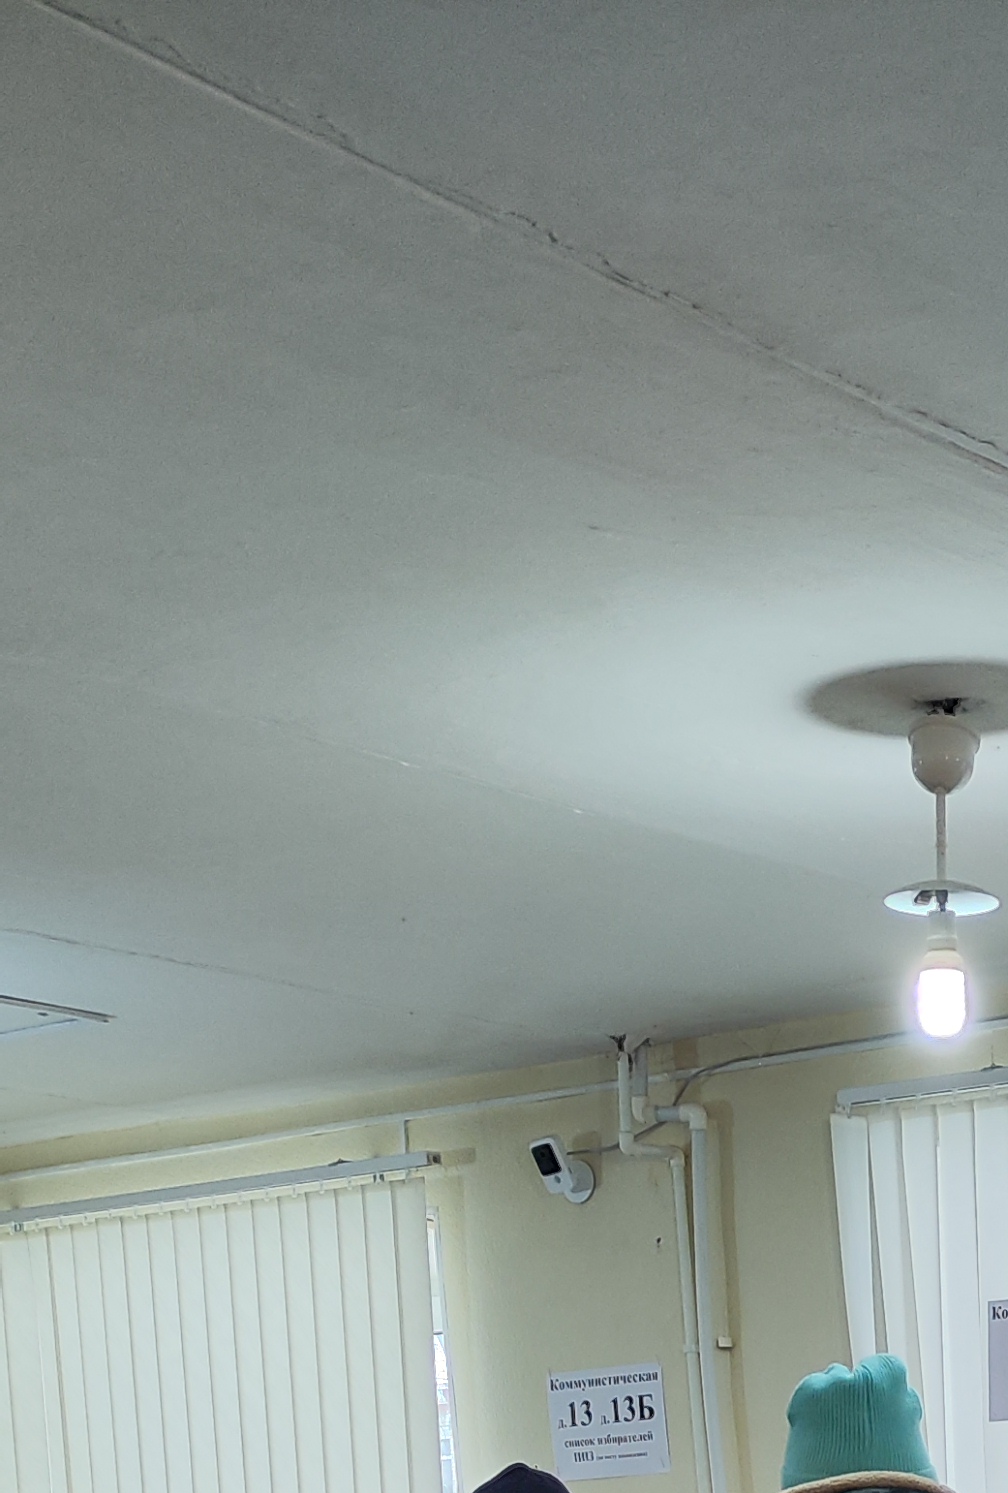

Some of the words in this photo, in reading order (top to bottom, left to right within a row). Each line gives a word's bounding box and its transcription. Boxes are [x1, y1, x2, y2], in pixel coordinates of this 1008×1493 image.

[550, 1371, 658, 1391] Коммунистическая
[558, 1400, 593, 1429] д.13
[600, 1394, 656, 1425] д.13Б
[564, 1438, 596, 1449] список
[597, 1431, 654, 1447] избирателей
